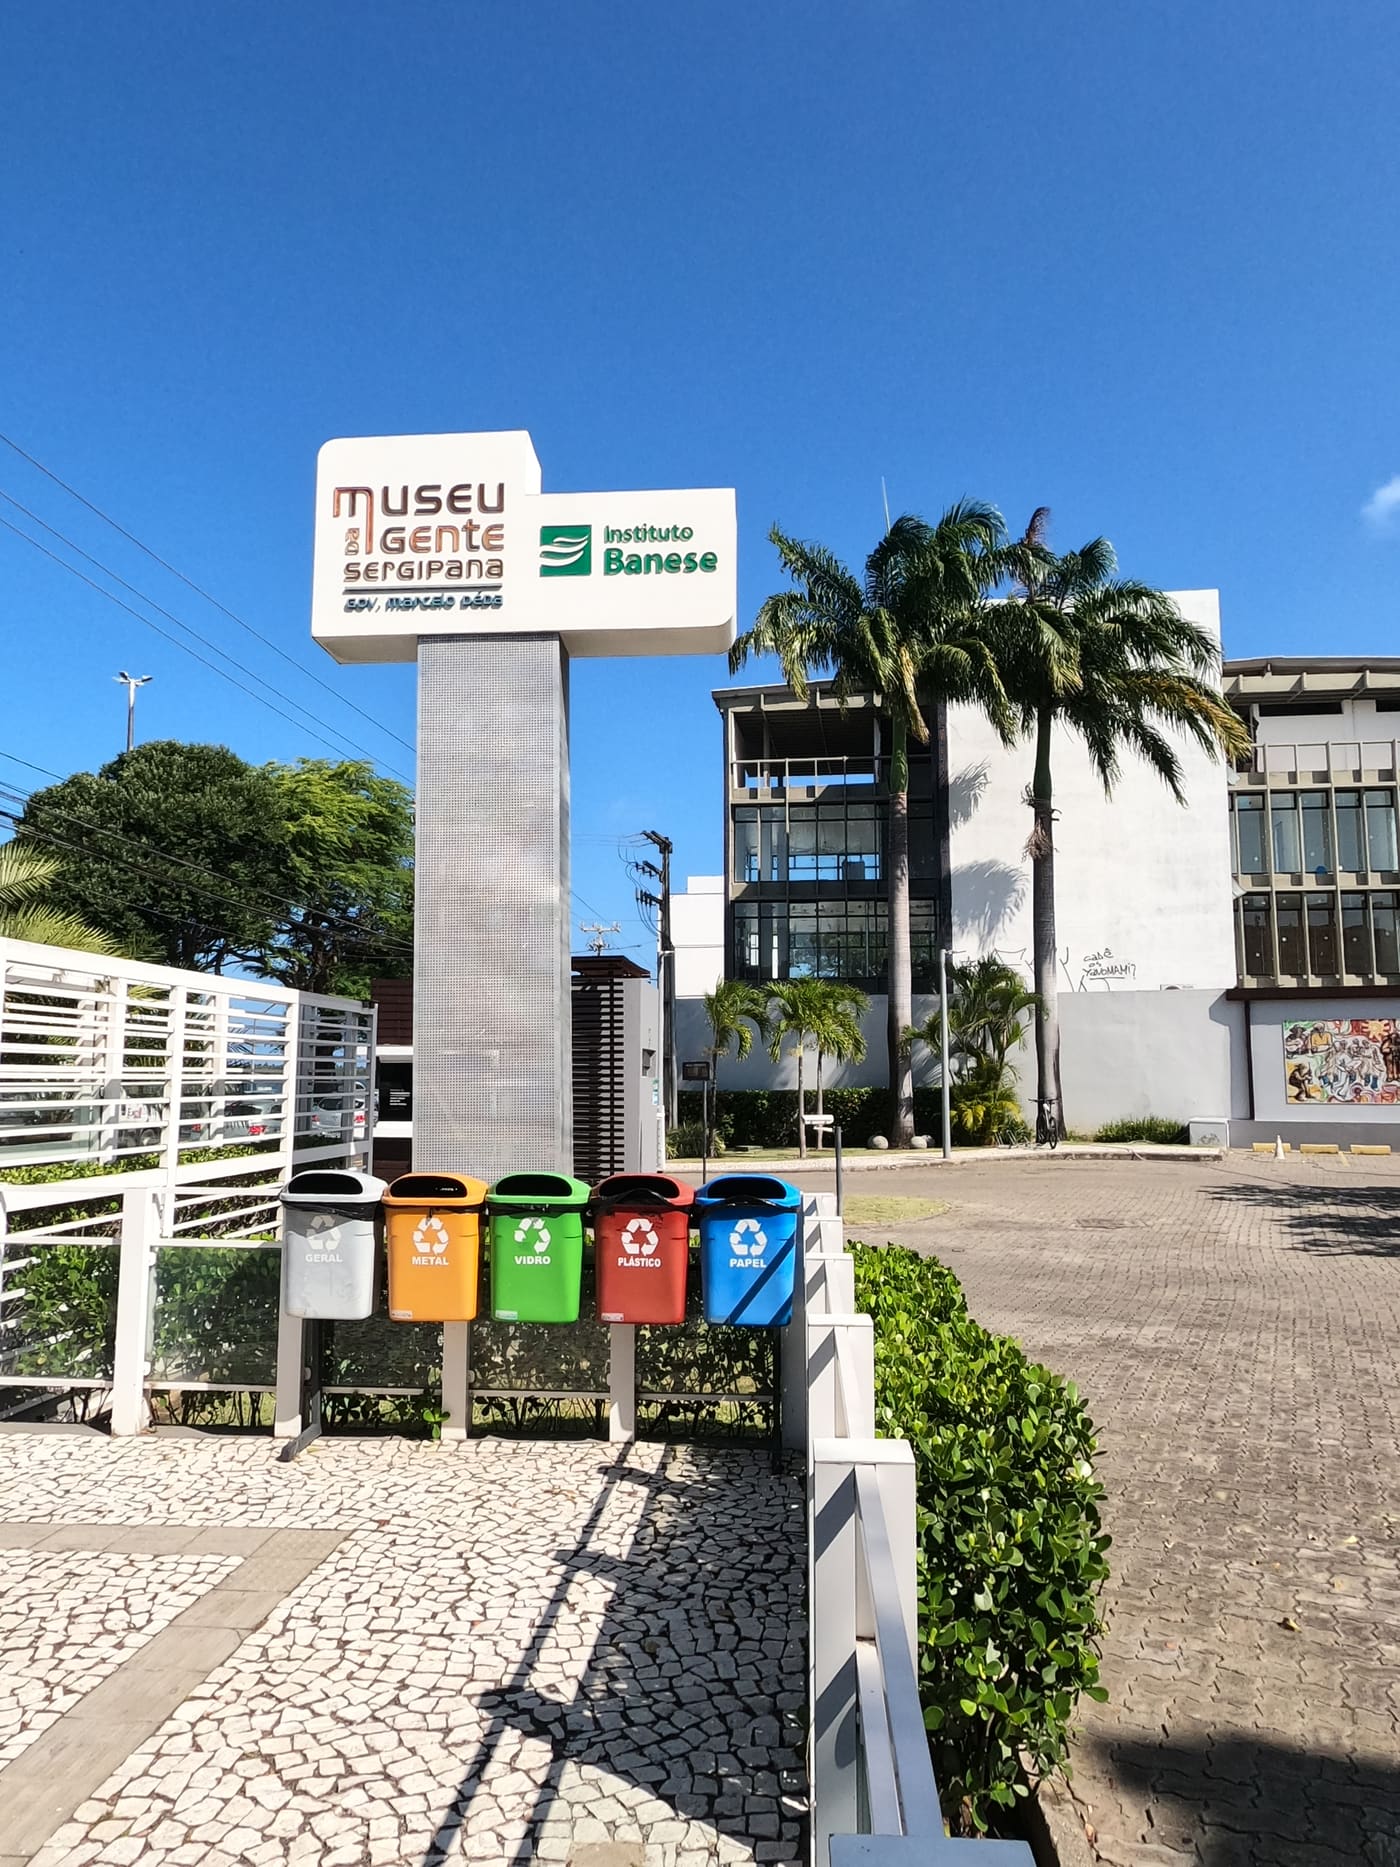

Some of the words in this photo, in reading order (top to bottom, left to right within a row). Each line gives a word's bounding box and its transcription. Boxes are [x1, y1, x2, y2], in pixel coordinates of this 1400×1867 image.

[603, 523, 694, 544] Instituto
[603, 547, 718, 576] Banese
[305, 1253, 343, 1263] GERAL
[411, 1255, 449, 1266] METAL
[514, 1255, 551, 1265] VIDRO
[617, 1254, 662, 1268] PLÁSTICO
[729, 1257, 767, 1268] PAPEL
